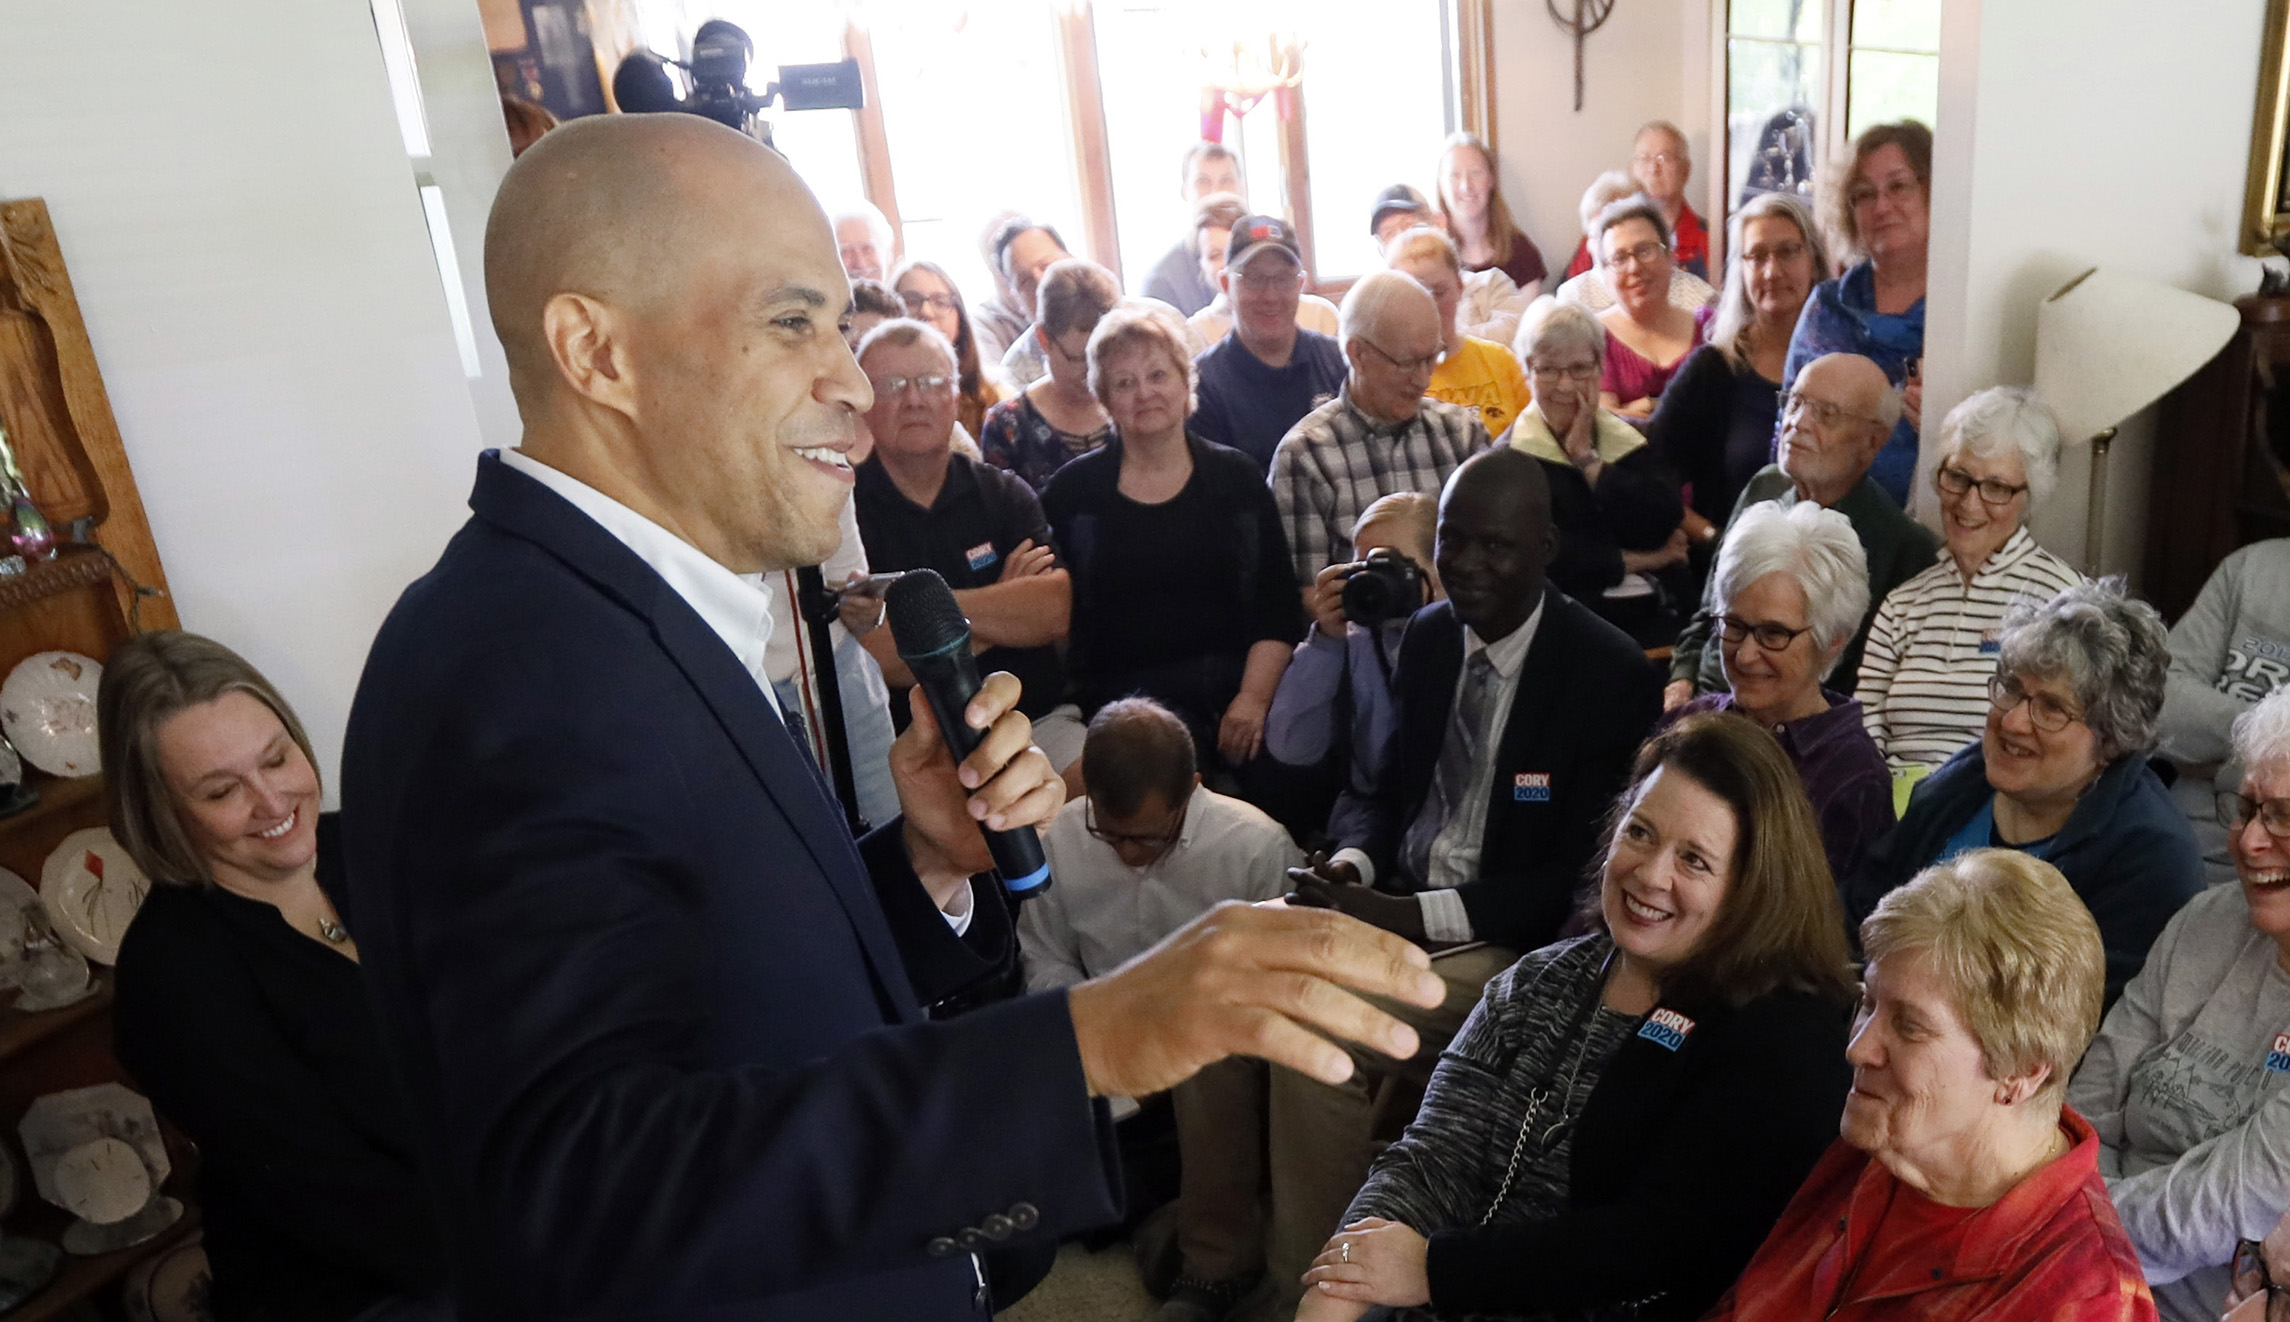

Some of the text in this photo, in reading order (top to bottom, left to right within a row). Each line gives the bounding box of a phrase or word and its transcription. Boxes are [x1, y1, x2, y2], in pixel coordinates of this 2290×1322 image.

[1515, 773, 1550, 786] CORY
[1516, 787, 1549, 799] 2020
[1651, 1008, 1696, 1034] CORY
[1640, 1022, 1683, 1048] 2020
